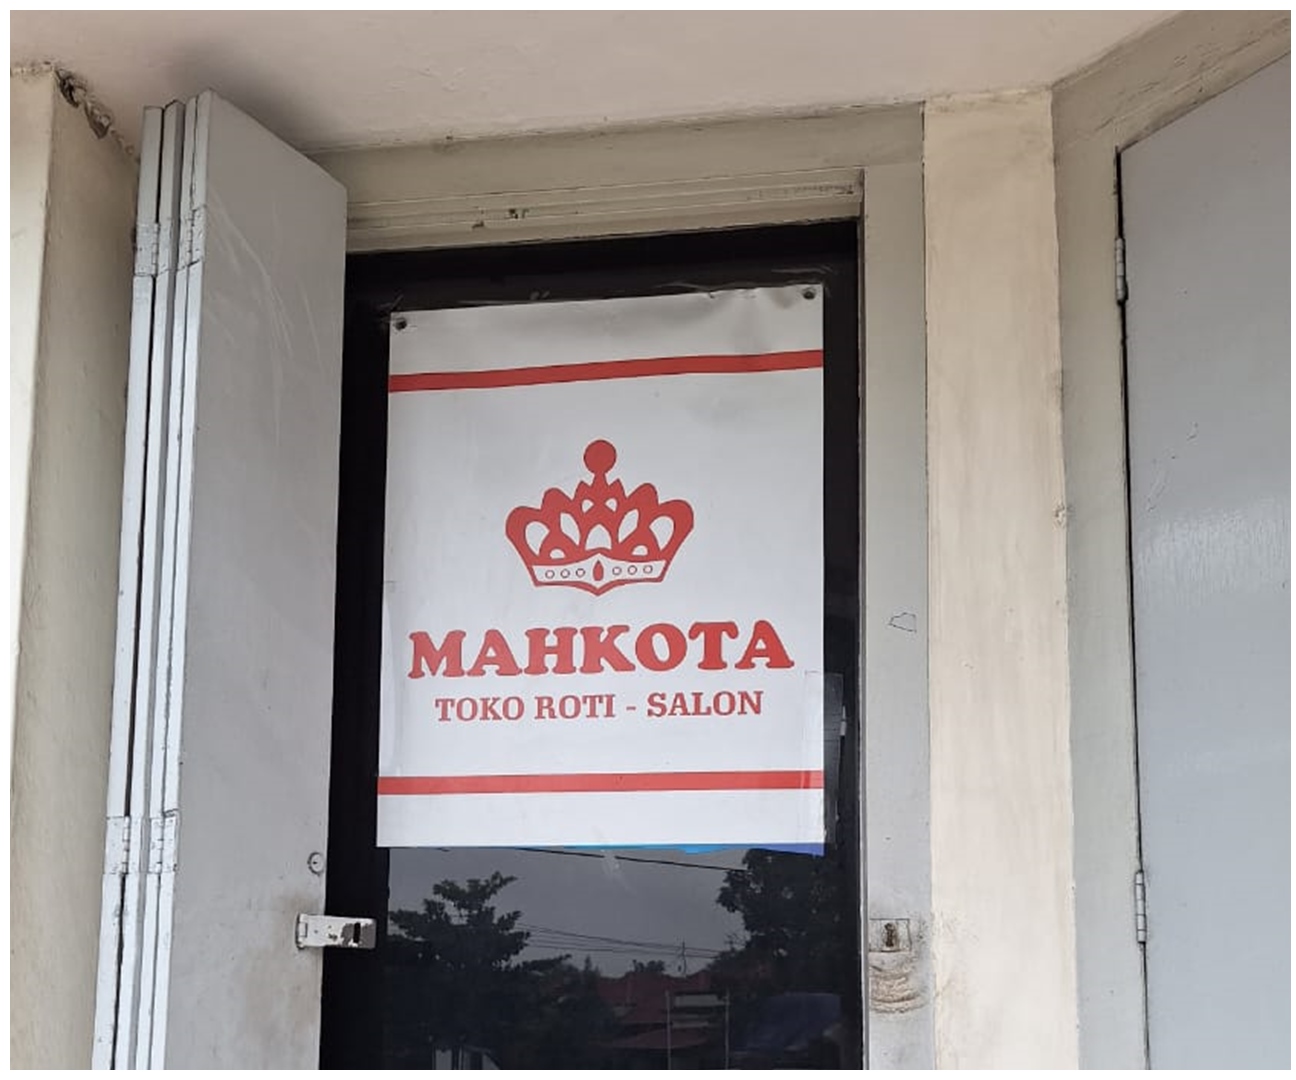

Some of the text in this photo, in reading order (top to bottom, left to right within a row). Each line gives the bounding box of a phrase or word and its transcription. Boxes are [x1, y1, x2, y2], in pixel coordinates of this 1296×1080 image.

[408, 619, 795, 679] MAHKOTA
[435, 697, 525, 722] TOKO
[534, 694, 616, 720] ROTI
[647, 690, 764, 718] SALON
